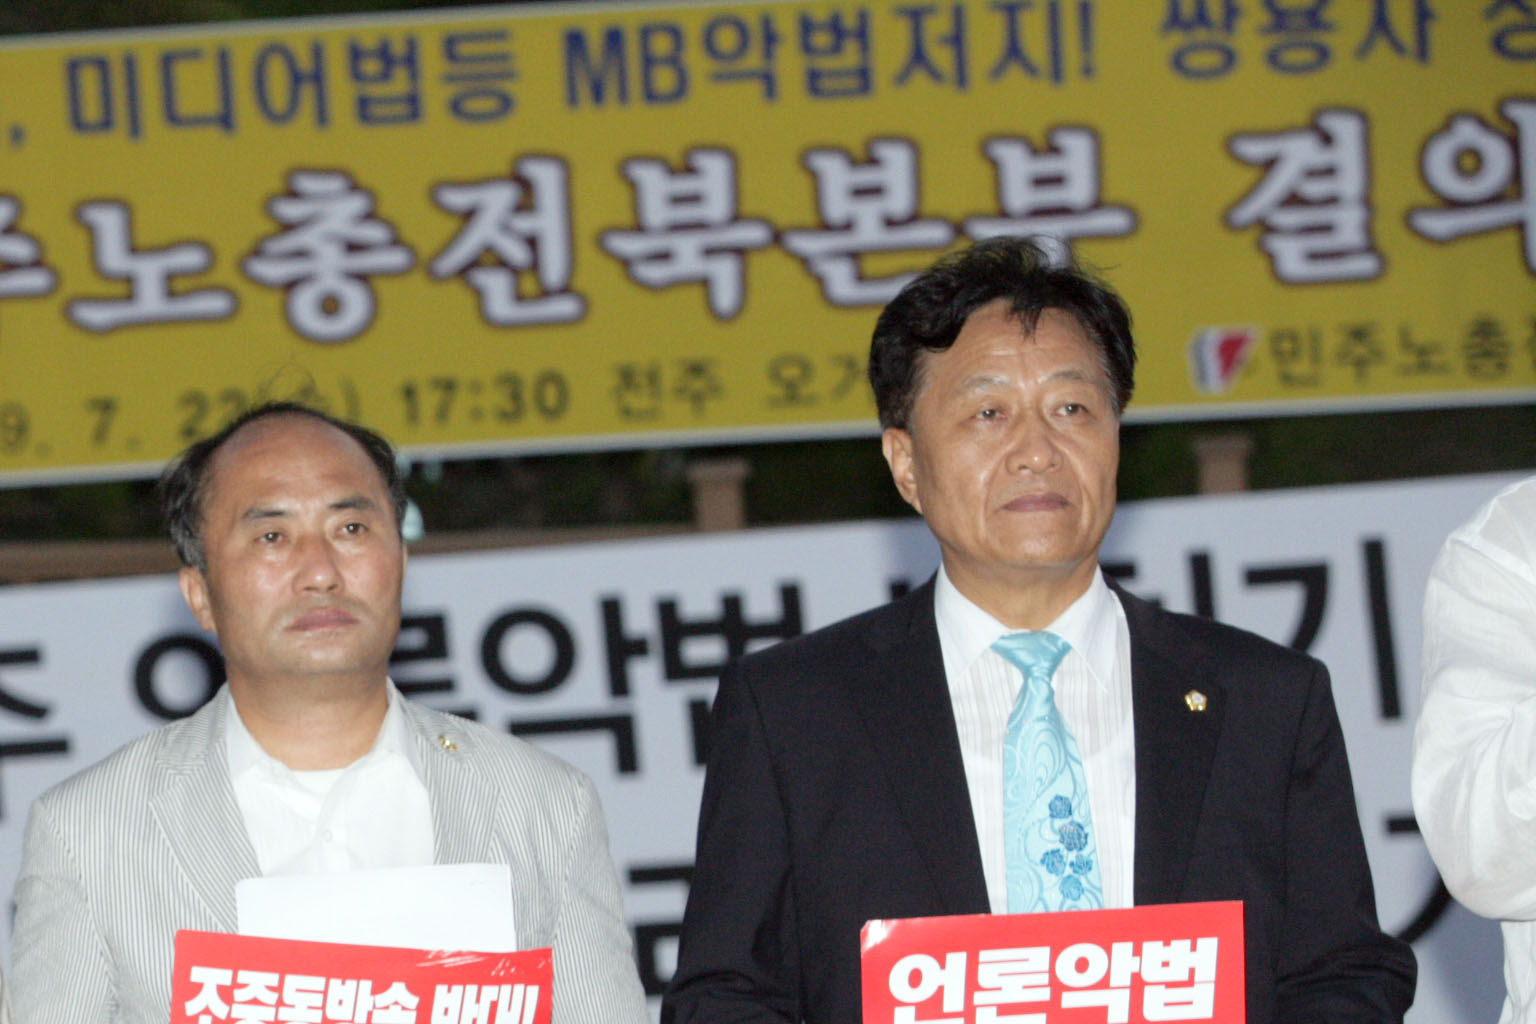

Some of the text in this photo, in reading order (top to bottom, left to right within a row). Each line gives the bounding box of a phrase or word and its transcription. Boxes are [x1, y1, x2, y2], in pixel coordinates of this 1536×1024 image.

[65, 28, 522, 142] 미디어법등
[565, 0, 1097, 110] MB악법저지!
[87, 396, 142, 454] 7.
[398, 369, 571, 430] 17:30
[611, 357, 725, 422] 전주
[1268, 312, 1536, 389] 민주노총
[132, 581, 807, 777] 악법
